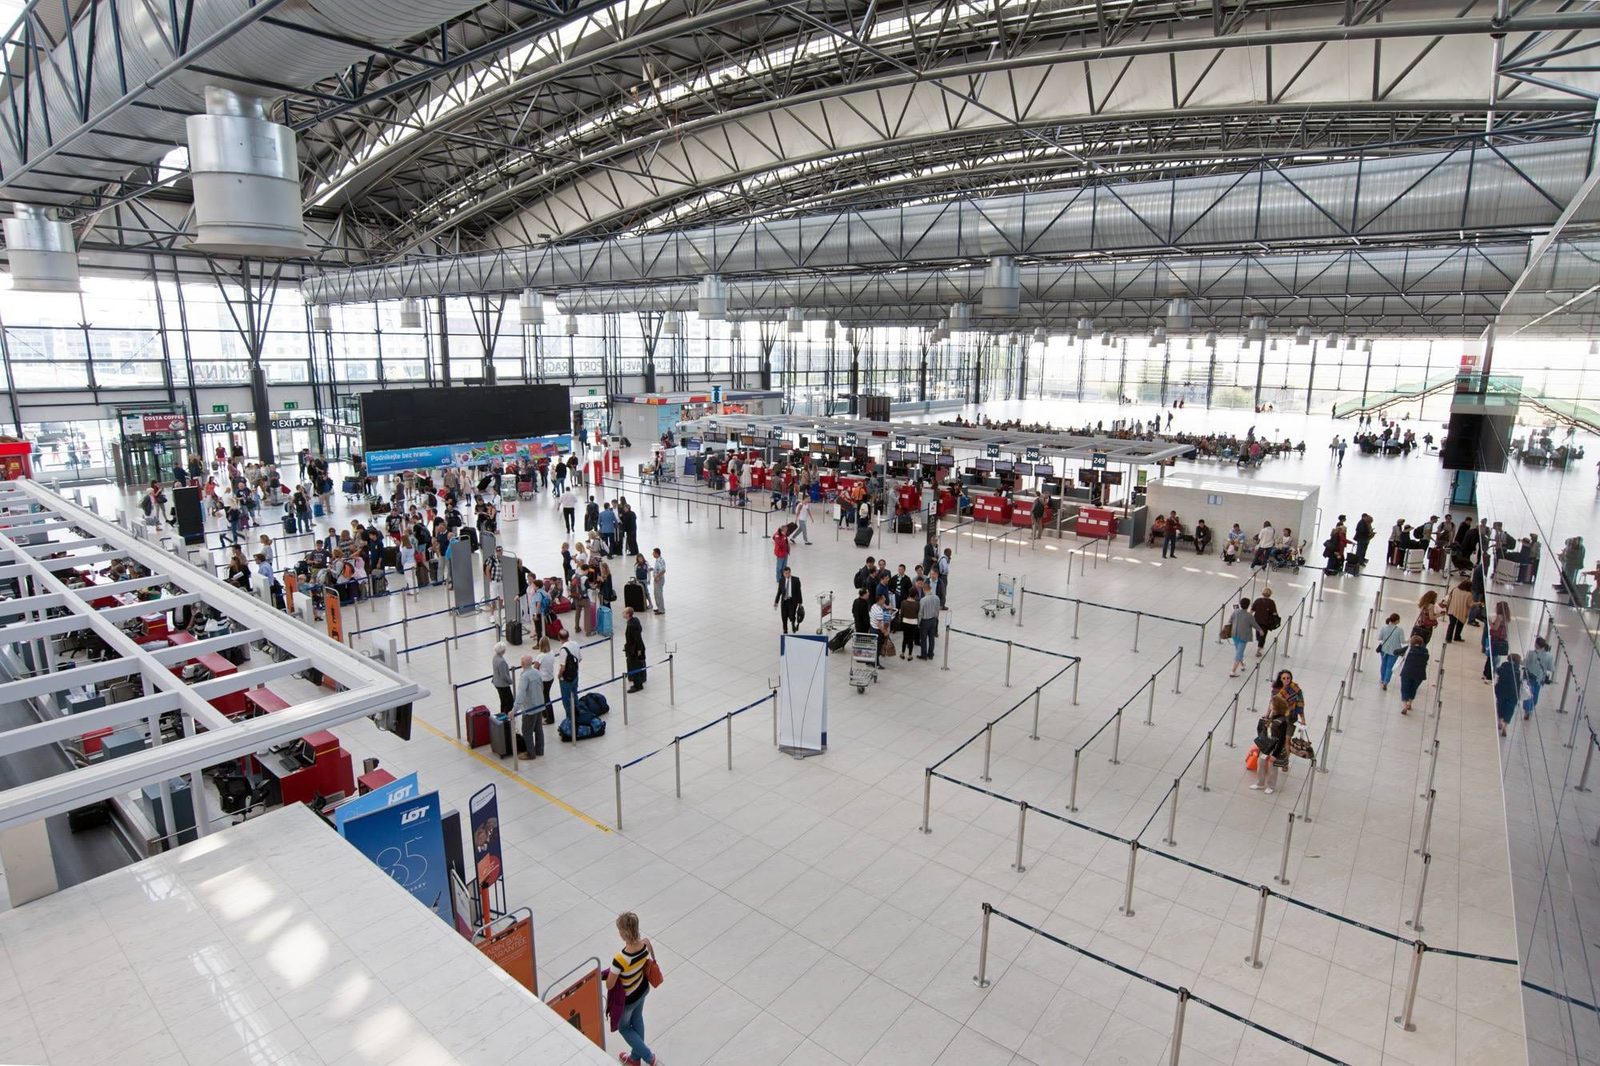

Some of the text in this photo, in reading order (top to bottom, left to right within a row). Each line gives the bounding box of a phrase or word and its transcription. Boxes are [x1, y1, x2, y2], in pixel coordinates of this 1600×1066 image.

[206, 423, 226, 432] EXIT
[278, 419, 296, 428] EXIT
[987, 446, 999, 454] 247
[1093, 456, 1106, 465] 249
[388, 784, 413, 806] LOT
[401, 805, 430, 825] LOT
